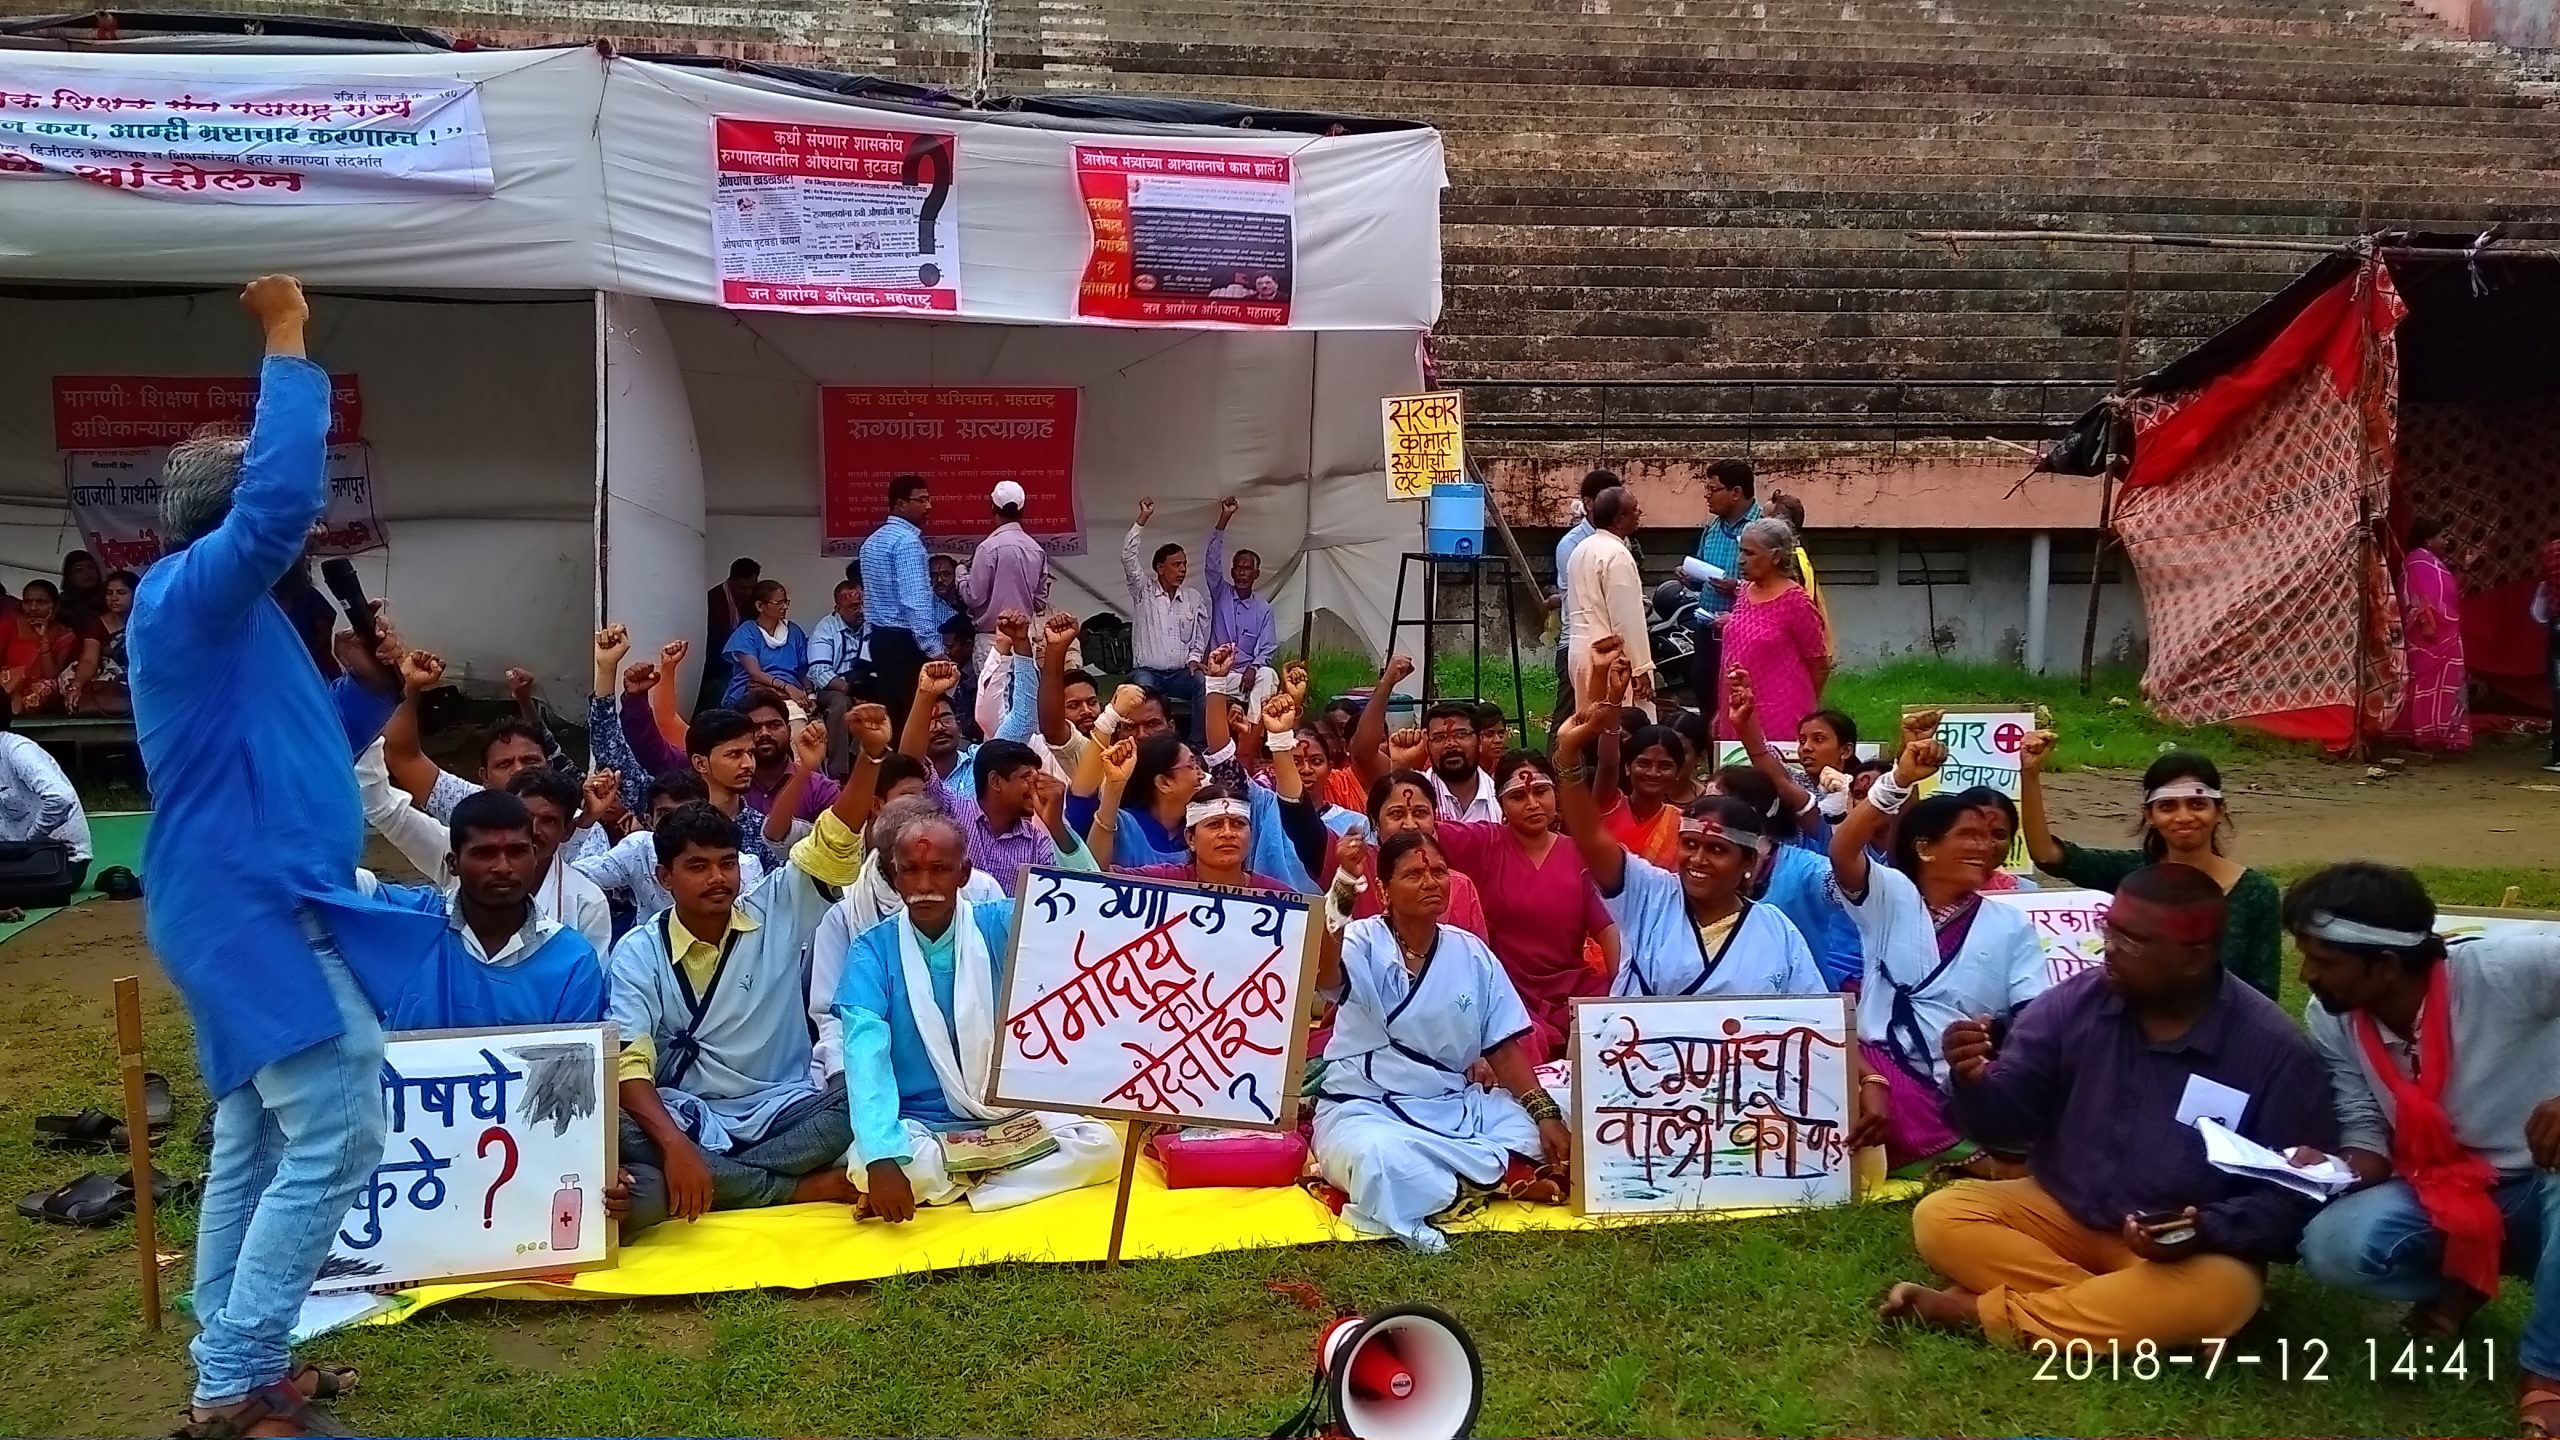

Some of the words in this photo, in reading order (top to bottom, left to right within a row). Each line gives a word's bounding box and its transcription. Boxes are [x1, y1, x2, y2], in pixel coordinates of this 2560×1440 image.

[109, 117, 190, 142] आम्ही
[199, 124, 300, 143] भ्रष्टाचार
[307, 127, 419, 147] करणारच
[774, 126, 801, 147] कधी
[806, 128, 849, 150] संपणार
[853, 133, 904, 154] शासकीय
[246, 153, 273, 167] इतर
[278, 154, 330, 168] मागण्या
[335, 153, 384, 168] संदर्भात
[720, 147, 800, 169] रुग्णालयातील
[805, 149, 858, 173] औषधांचा
[864, 158, 904, 178] तुटवडा
[1082, 149, 1118, 168] आरोग्य
[1168, 156, 1225, 175] आश्वासनाचं
[1228, 160, 1251, 175] काय
[747, 288, 771, 302] जन
[775, 286, 820, 303] आरोग्य
[825, 288, 879, 305] अभियान,
[884, 291, 932, 310] महाराष्ट्र
[1143, 302, 1160, 315] जन
[1165, 299, 1197, 316] आरोग्य
[1247, 306, 1282, 322] महाराष्ट्र
[139, 386, 199, 409] शिक्षण
[846, 393, 871, 407] जन
[878, 390, 929, 407] आरोग्य
[1004, 393, 1055, 409] महाराष्ट्र
[848, 411, 944, 440] रुग्णांचा
[956, 418, 1055, 441] सत्याग्रह
[1389, 396, 1459, 433] सरकार
[72, 477, 116, 506] खाजगी
[120, 477, 164, 505] प्राथमि
[331, 476, 364, 504] नागपूर
[1392, 471, 1422, 496] लूट
[339, 1137, 451, 1250] कुठे
[477, 1126, 519, 1229] ?
